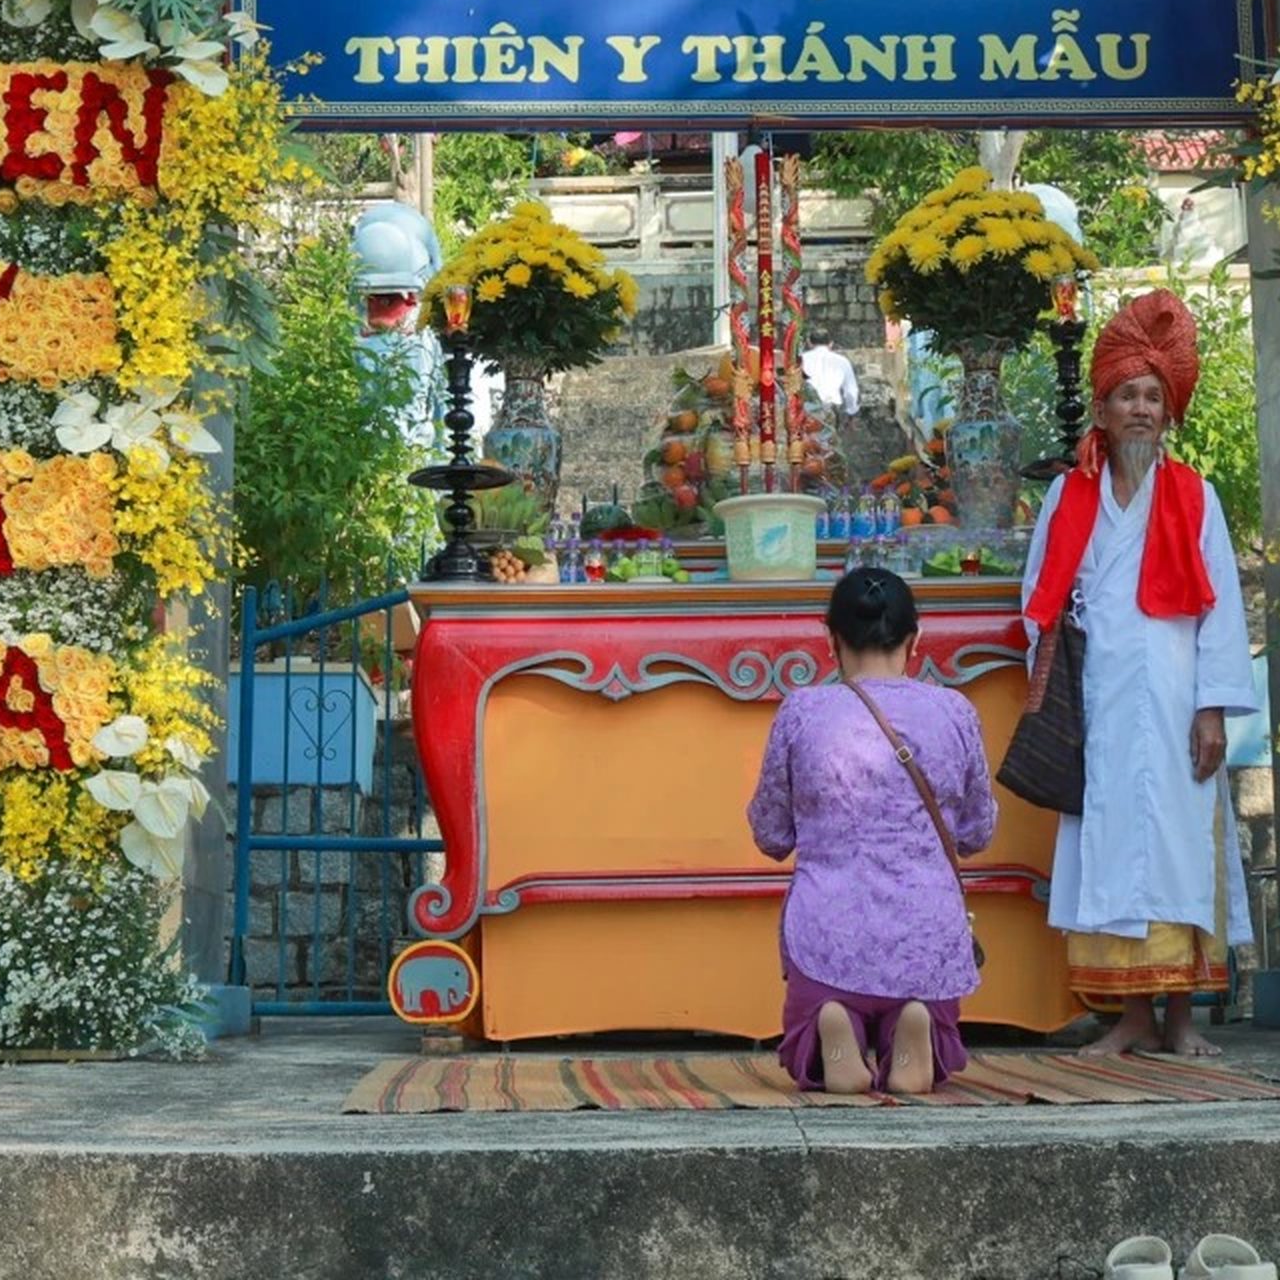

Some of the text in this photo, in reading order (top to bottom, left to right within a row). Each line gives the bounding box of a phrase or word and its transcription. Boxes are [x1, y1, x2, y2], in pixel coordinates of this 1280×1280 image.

[344, 9, 1152, 85] THIÊN Y THÁNH MẪU
